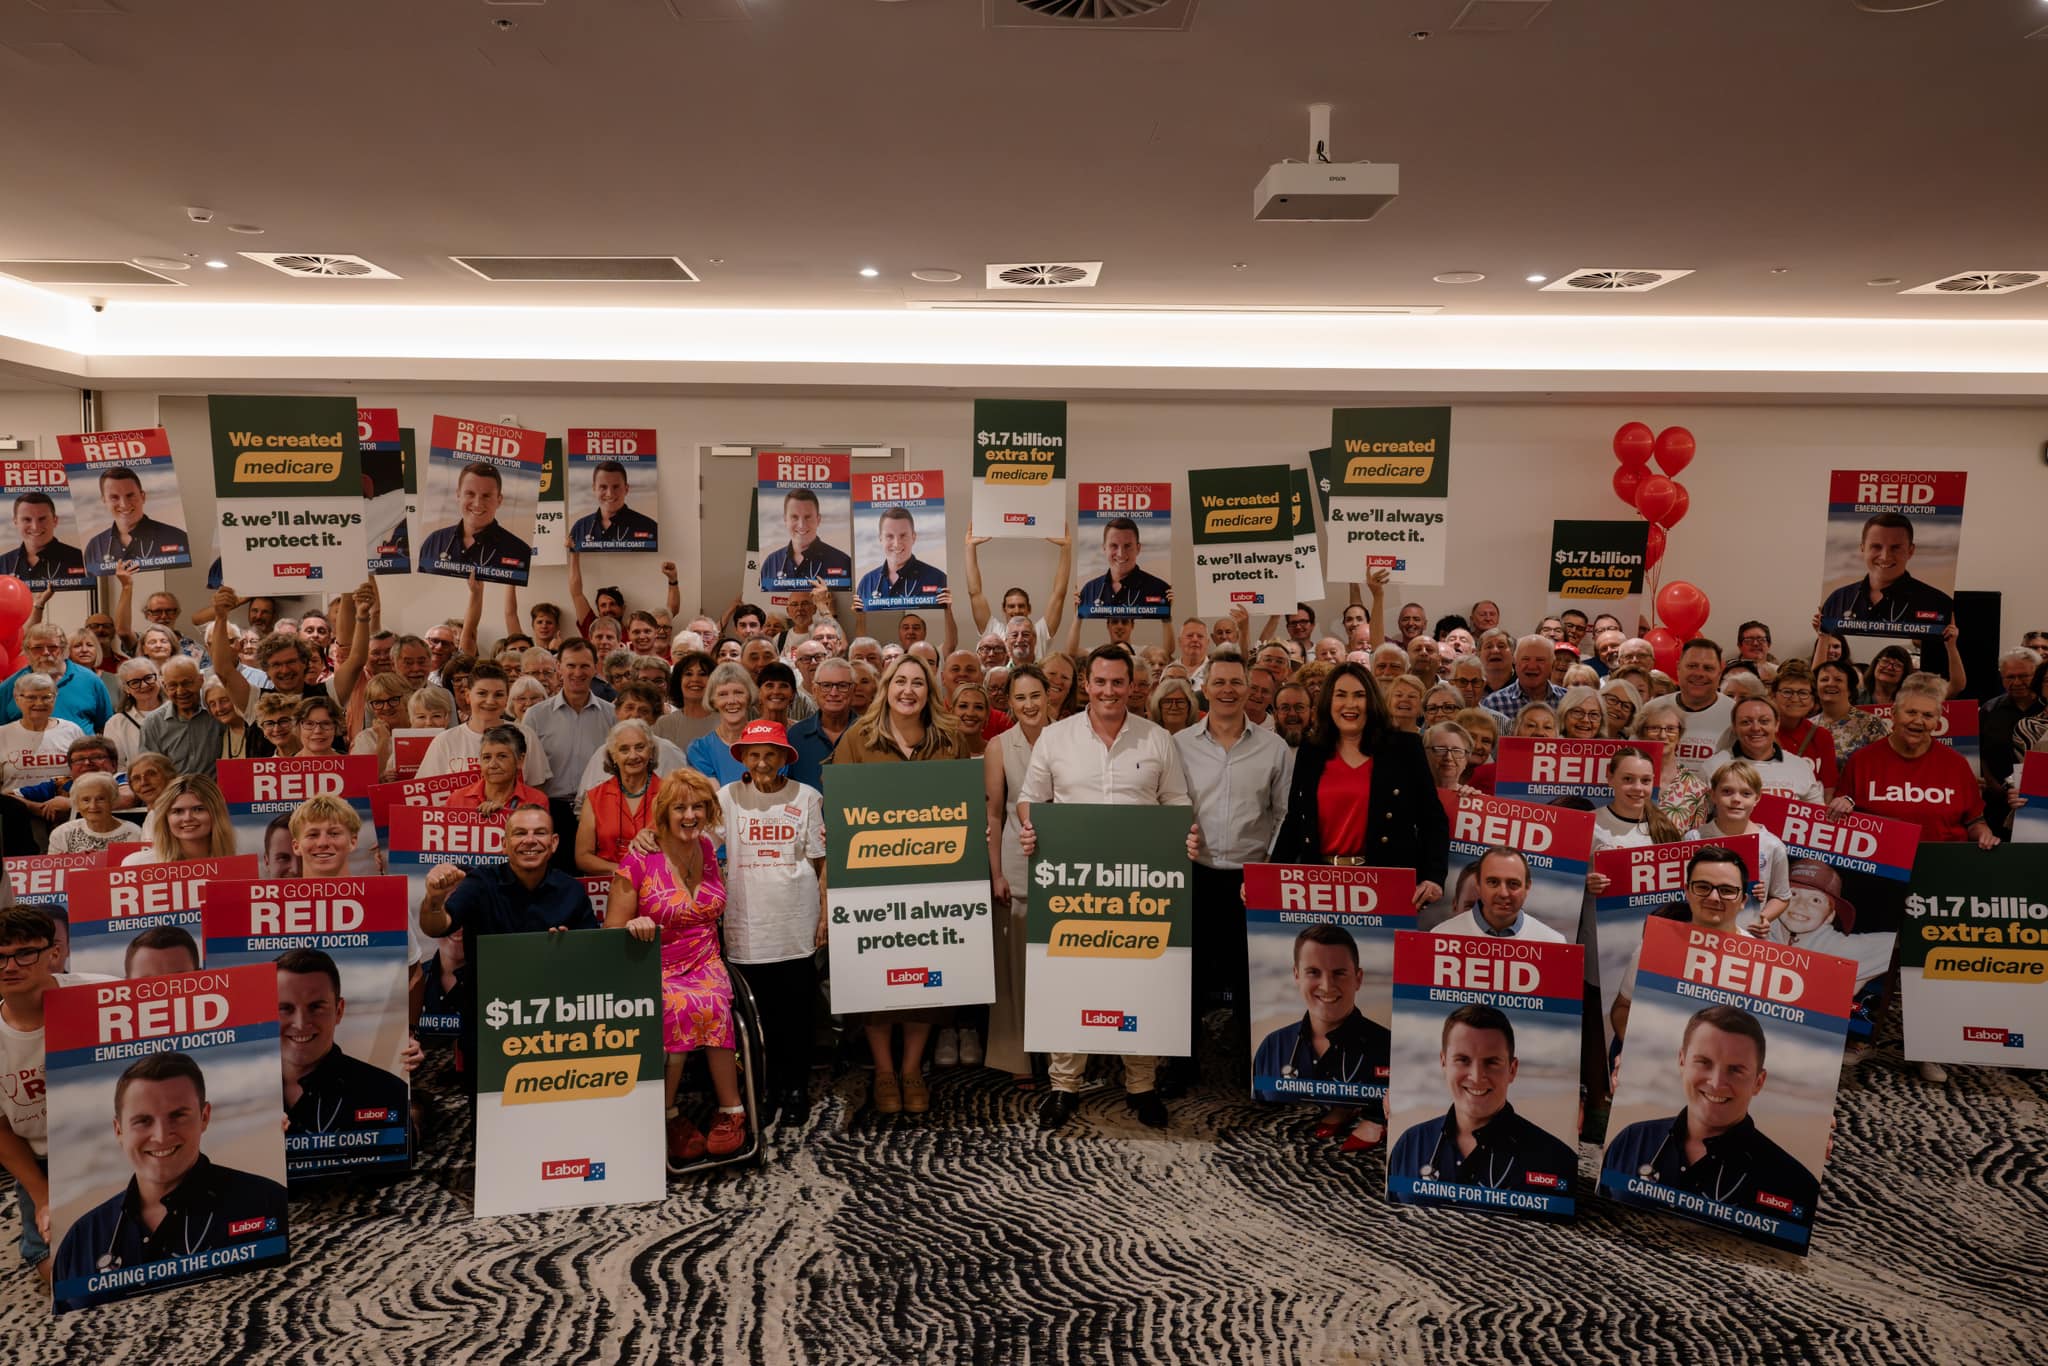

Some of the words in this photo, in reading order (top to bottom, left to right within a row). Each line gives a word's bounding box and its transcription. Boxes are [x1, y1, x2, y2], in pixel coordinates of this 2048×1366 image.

[81, 436, 98, 444] DR
[99, 431, 144, 443] GORDON
[457, 421, 474, 433] DR
[476, 424, 523, 440] GORDON
[600, 431, 638, 439] GORDON
[977, 430, 1010, 448] $1.7
[1012, 432, 1063, 447] billion
[228, 431, 263, 448] We
[266, 431, 343, 448] created
[456, 431, 521, 458] REID
[587, 438, 637, 454] REID
[1345, 439, 1371, 453] We
[1372, 438, 1436, 453] created
[83, 440, 147, 463] REID
[452, 451, 493, 465] EMERGENCY
[493, 457, 521, 469] DOCTOR
[985, 448, 1029, 462] extra
[1031, 447, 1054, 462] for
[4, 462, 21, 470] DR
[86, 459, 126, 470] EMERGENCY
[126, 457, 152, 467] DOCTOR
[243, 458, 334, 476] medicare
[778, 456, 791, 464] DR
[792, 456, 831, 465] GORDON
[5, 469, 66, 486] REID
[778, 465, 831, 481] REID
[871, 475, 885, 483] DR
[886, 473, 924, 483] GORDON
[991, 467, 1049, 481] medicare
[1352, 464, 1425, 477] medicare
[1859, 473, 1878, 483] DR
[1880, 473, 1936, 484] GORDON
[871, 482, 924, 500] REID
[1098, 485, 1112, 493] DR
[1113, 485, 1152, 493] GORDON
[1856, 484, 1935, 505] REID
[1098, 494, 1151, 510] REID
[1201, 495, 1225, 508] We
[1227, 492, 1280, 506] created
[1332, 509, 1344, 522] &
[1347, 508, 1384, 522] we’ll
[1386, 509, 1444, 526] always
[1854, 504, 1901, 514] EMERGENCY
[1903, 505, 1936, 515] DOCTOR
[222, 511, 239, 527] &
[242, 510, 289, 527] we’ll
[293, 510, 362, 531] always
[1004, 514, 1026, 523] Labor
[1211, 514, 1273, 528] medicare
[245, 533, 318, 552] protect
[321, 532, 343, 548] it.
[1347, 529, 1406, 543] protect
[1408, 529, 1425, 542] it.
[1197, 555, 1208, 566] &
[1211, 553, 1242, 566] we’ll
[1244, 553, 1293, 567] always
[1368, 557, 1393, 566] Labor
[1554, 549, 1589, 565] $1.7
[1590, 551, 1642, 565] billion
[276, 565, 308, 577] Labor
[1212, 570, 1262, 583] protect
[1264, 568, 1279, 580] it.
[1561, 566, 1606, 578] extra
[1606, 565, 1633, 578] for
[1566, 585, 1625, 595] medicare
[1837, 620, 1867, 631] CARING
[1869, 621, 1884, 631] FOR
[1886, 622, 1901, 632] THE
[1903, 624, 1930, 634] COAST
[747, 726, 773, 734] Labor
[22, 754, 68, 767] REID
[252, 762, 276, 774] DR
[279, 760, 345, 772] GORDON
[1868, 780, 1956, 805] Labor
[844, 807, 880, 826] We
[883, 802, 968, 823] created
[1459, 797, 1483, 811] DR
[1486, 801, 1557, 824] GORDON
[750, 818, 759, 826] Dr
[749, 826, 795, 841] REID
[1455, 812, 1553, 852] REID
[1782, 816, 1878, 858] REID
[858, 837, 957, 859] medicare
[110, 871, 137, 885] DR
[141, 863, 218, 882] GORDON
[1034, 859, 1091, 888] $1.7
[1096, 863, 1185, 888] billion
[1280, 869, 1305, 881] DR
[1307, 870, 1378, 884] GORDON
[250, 885, 279, 899] DR
[283, 882, 365, 898] GORDON
[1281, 883, 1378, 912] REID
[832, 905, 850, 924] &
[853, 902, 907, 922] we’ll
[910, 899, 988, 922] always
[1048, 891, 1124, 914] extra
[1128, 891, 1171, 916] for
[1905, 895, 1965, 919] $1.7
[251, 899, 365, 934] REID
[1279, 912, 1339, 925] EMERGENCY
[1341, 914, 1383, 927] DOCTOR
[857, 931, 938, 954] protect
[942, 927, 965, 946] it.
[1058, 930, 1160, 950] medicare
[1921, 924, 2003, 944] extra
[247, 937, 320, 951] EMERGENCY
[321, 935, 369, 949] DOCTOR
[1434, 939, 1461, 955] DR
[1464, 941, 1542, 961] GORDON
[1689, 931, 1719, 950] DR
[1723, 937, 1810, 971] GORDON
[1433, 955, 1540, 993] REID
[1935, 956, 2045, 976] medicare
[890, 971, 925, 983] Labor
[1683, 948, 1805, 1003] REID
[97, 987, 132, 1003] DR
[136, 974, 230, 999] GORDON
[1429, 989, 1496, 1007] EMERGENCY
[1498, 995, 1544, 1011] DOCTOR
[1676, 981, 1753, 1011] EMERGENCY
[1753, 1000, 1805, 1024] DOCTOR
[98, 994, 230, 1043] REID
[485, 998, 550, 1030] $1.7
[556, 993, 655, 1023] billion
[1085, 1012, 1120, 1025] Labor
[502, 1030, 588, 1057] extra
[592, 1024, 640, 1050] for
[1967, 1029, 2005, 1041] Labor
[95, 1037, 180, 1062] EMERGENCY
[181, 1030, 236, 1050] DOCTOR
[514, 1069, 628, 1093] medicare
[357, 1109, 385, 1121] Labor
[546, 1163, 585, 1178] Labor
[1528, 1172, 1555, 1186] Labor
[1412, 1181, 1457, 1199] CARING
[1459, 1186, 1482, 1202] FOR
[1484, 1189, 1507, 1205] THE
[1510, 1192, 1549, 1211] COAST
[1759, 1191, 1790, 1210] Labor
[1627, 1178, 1675, 1204] CARING
[1678, 1189, 1705, 1212] FOR
[1708, 1196, 1734, 1220] THE
[1735, 1206, 1780, 1234] COAST
[232, 1220, 263, 1233] Labor
[87, 1268, 144, 1292] CARING
[148, 1260, 177, 1279] FOR
[180, 1255, 209, 1273] THE
[211, 1244, 258, 1267] COAST
